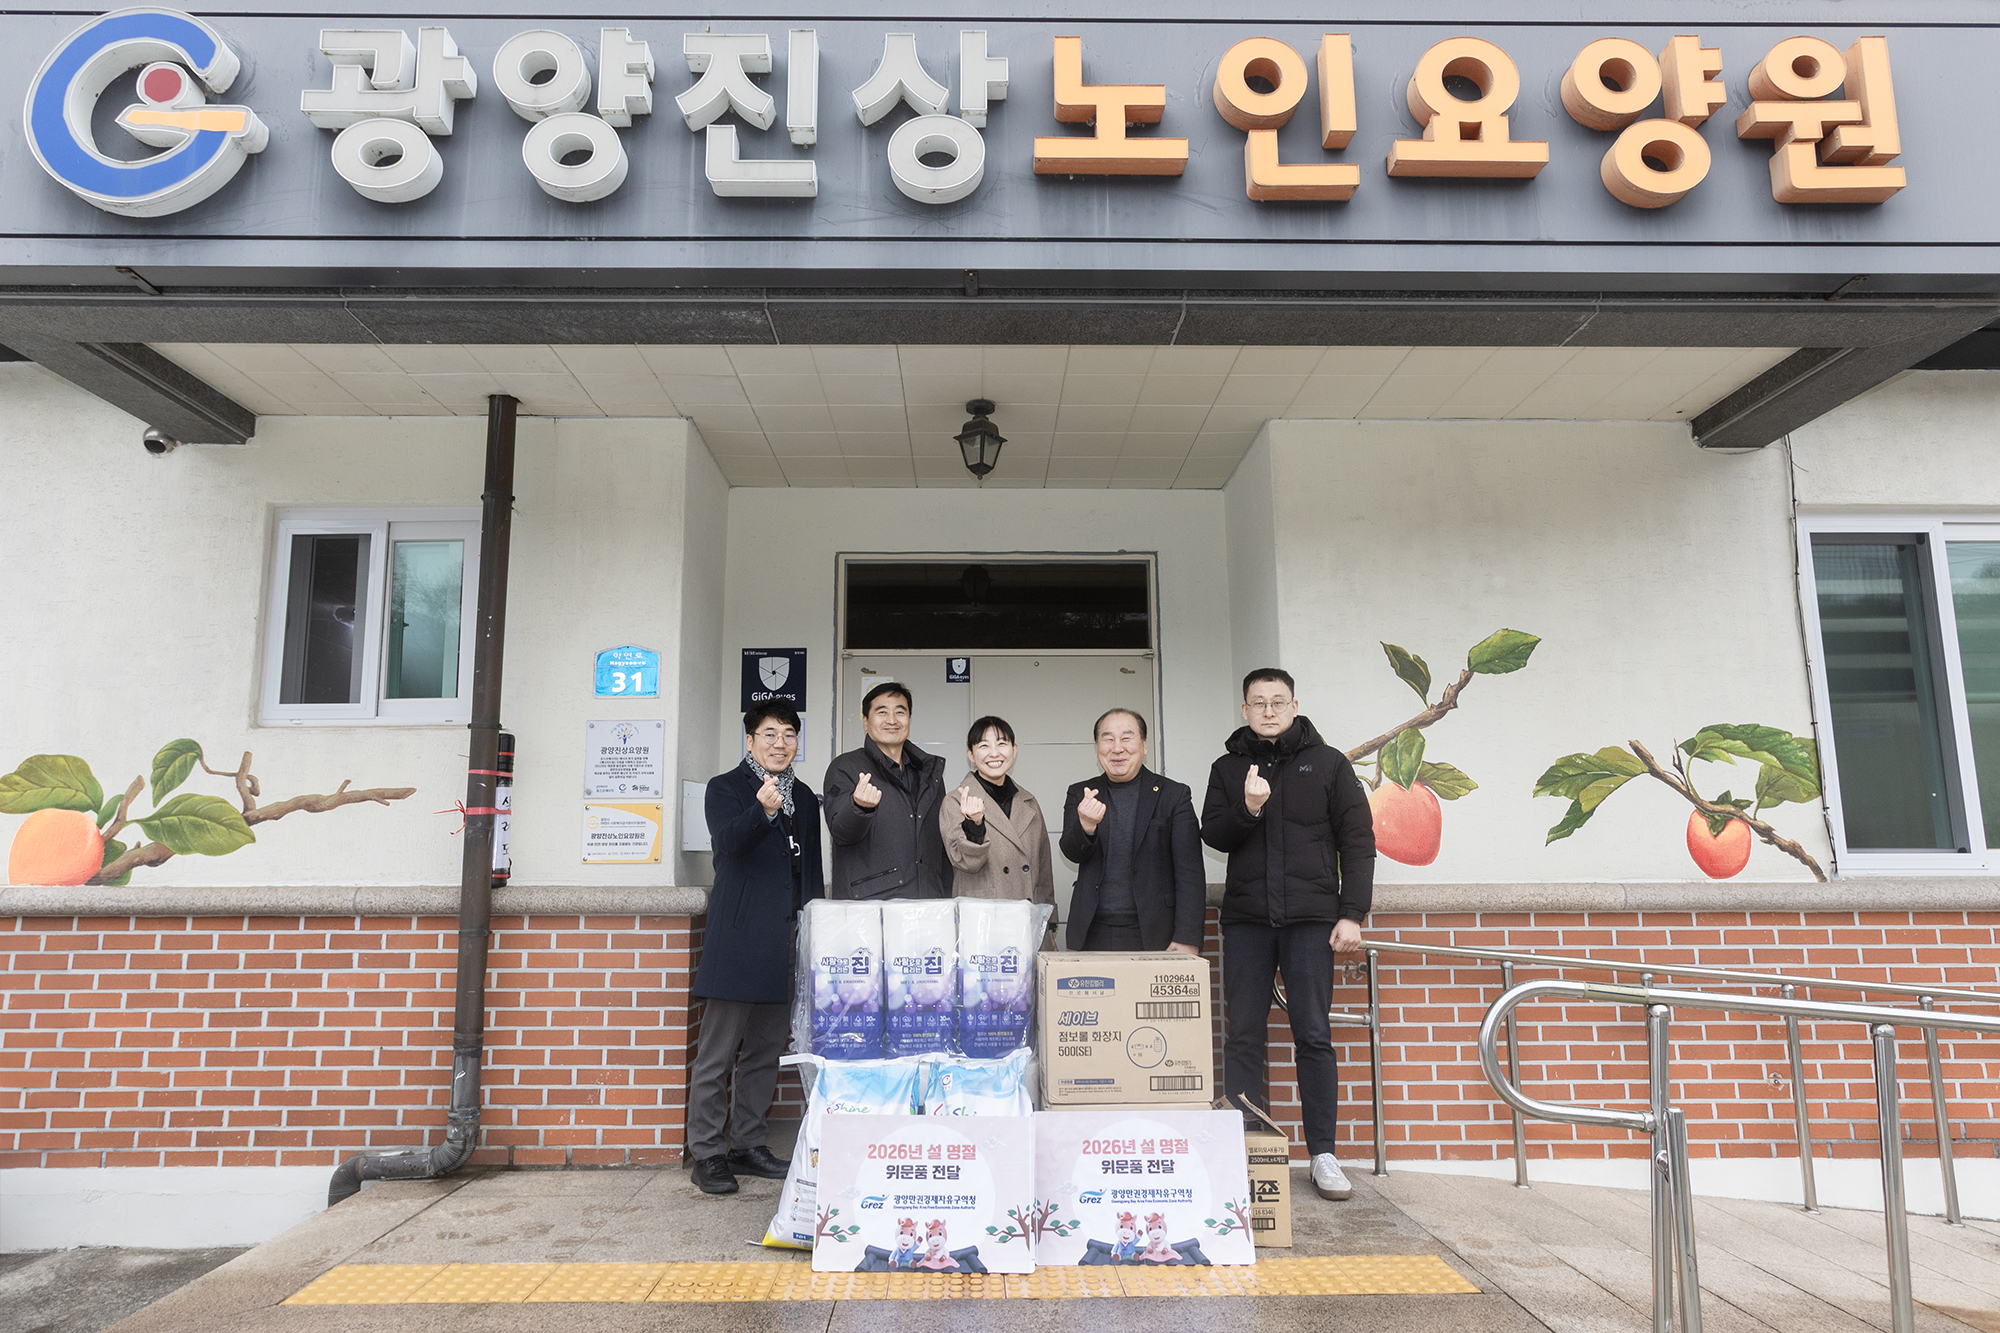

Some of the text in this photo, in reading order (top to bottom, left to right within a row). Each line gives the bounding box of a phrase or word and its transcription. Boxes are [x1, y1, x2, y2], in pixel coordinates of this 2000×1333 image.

[301, 25, 1907, 209] 광양진상노인요양원
[613, 652, 643, 660] 학연로
[612, 672, 642, 693] 31
[600, 746, 649, 755] 광양진상요양원
[852, 956, 869, 974] 집
[924, 956, 942, 974] 집
[1000, 955, 1017, 974] 집
[1080, 979, 1104, 988] 유한킴벌리
[1154, 975, 1195, 983] 11029644
[1058, 1011, 1098, 1026] 세이브
[1058, 1031, 1122, 1043] 점보롤 화장지
[868, 1144, 976, 1160] 2026년 설 명절
[1082, 1139, 1189, 1155] 2026년 설 명절
[886, 1164, 960, 1180] 위문품 전달
[1102, 1159, 1175, 1174] 위문품 전달
[894, 1194, 976, 1205] 광양만권경제자유구역청
[1111, 1188, 1192, 1199] 광양만권경제자유구역청
